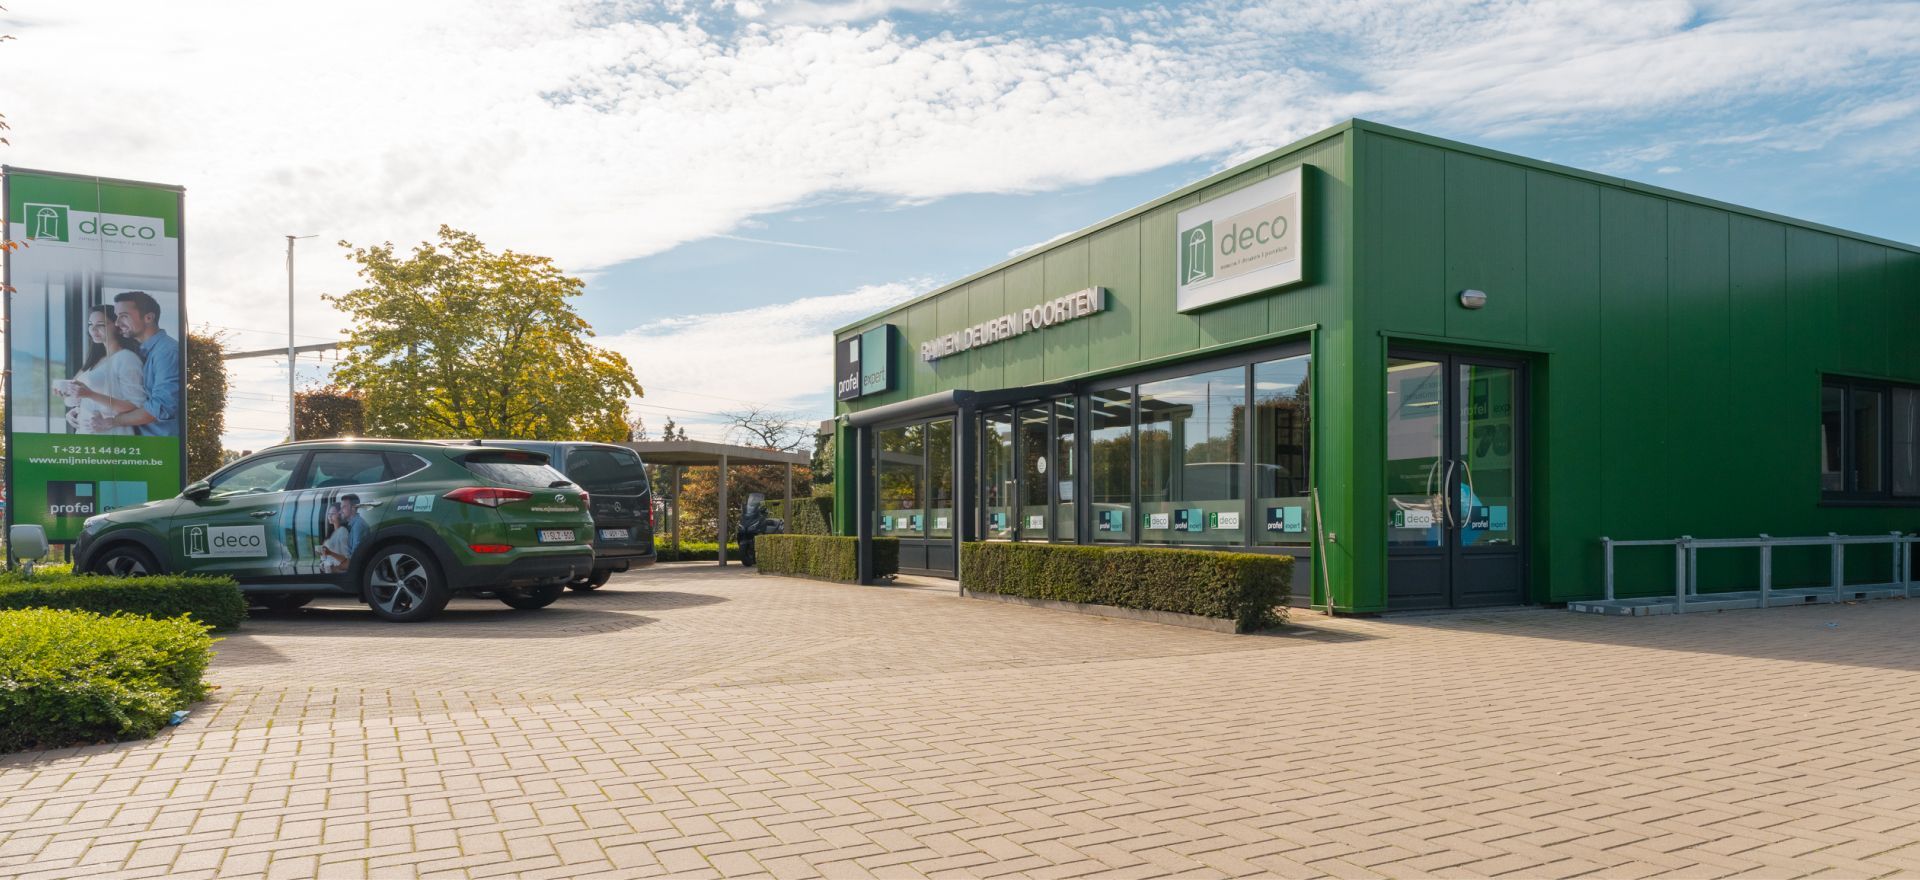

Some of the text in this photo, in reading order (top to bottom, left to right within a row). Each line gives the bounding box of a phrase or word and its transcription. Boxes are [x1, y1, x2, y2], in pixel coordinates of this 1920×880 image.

[79, 216, 156, 240] deco
[1220, 215, 1288, 256] deco
[920, 285, 1102, 362] RAMEN DEUREN POORTEN
[863, 364, 886, 387] expert
[838, 371, 859, 398] profel
[52, 445, 141, 456] T +32 11 44 84 21
[29, 456, 163, 466] www.mijnnieuweramen.be
[50, 502, 94, 515] profel
[1219, 516, 1238, 525] deco
[1407, 513, 1430, 523] deco
[1471, 520, 1489, 529] profel
[1267, 520, 1283, 530] profel
[213, 531, 261, 548] deco
